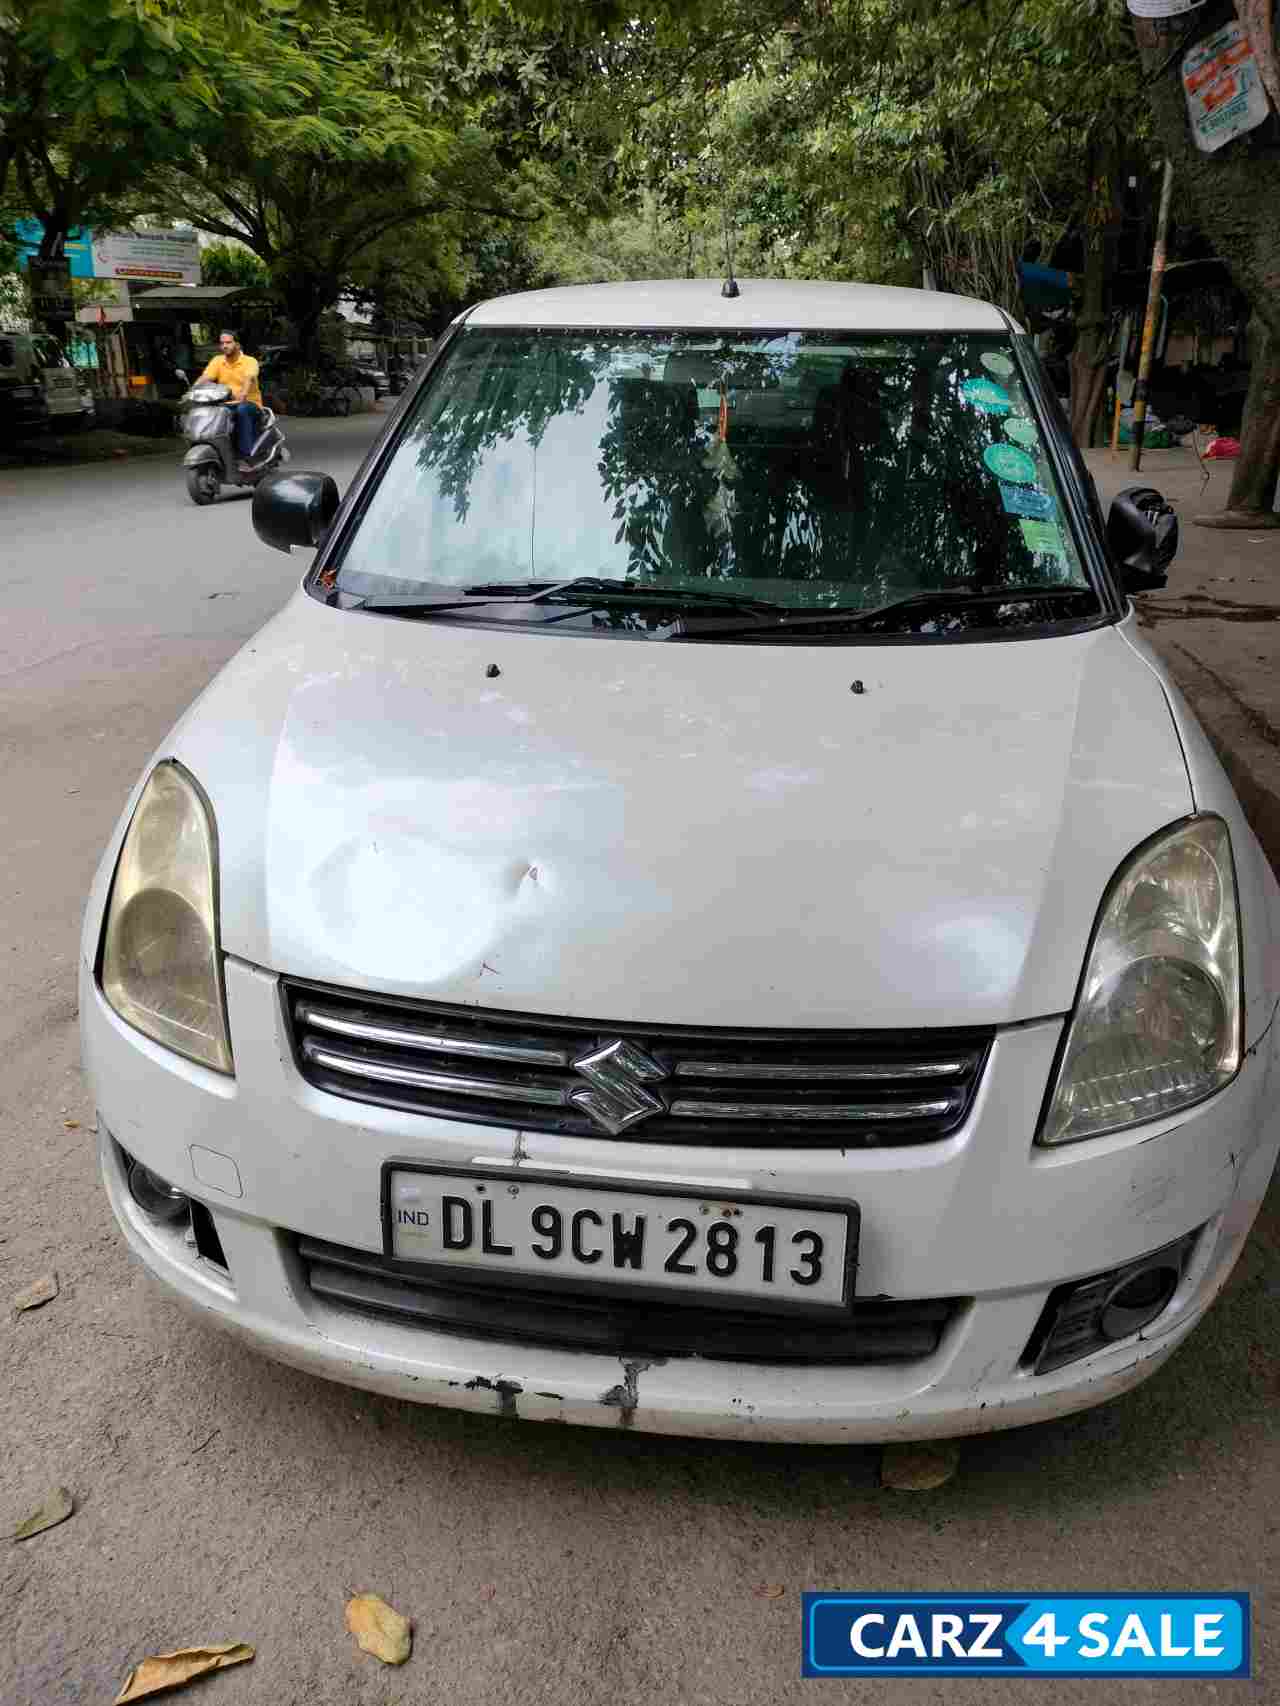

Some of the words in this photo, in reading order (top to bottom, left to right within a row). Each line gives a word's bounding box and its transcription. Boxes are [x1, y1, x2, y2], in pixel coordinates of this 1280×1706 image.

[397, 1210, 430, 1227] IND
[441, 1195, 514, 1256] DL
[531, 1204, 646, 1270] 9CW
[664, 1218, 824, 1287] 2813
